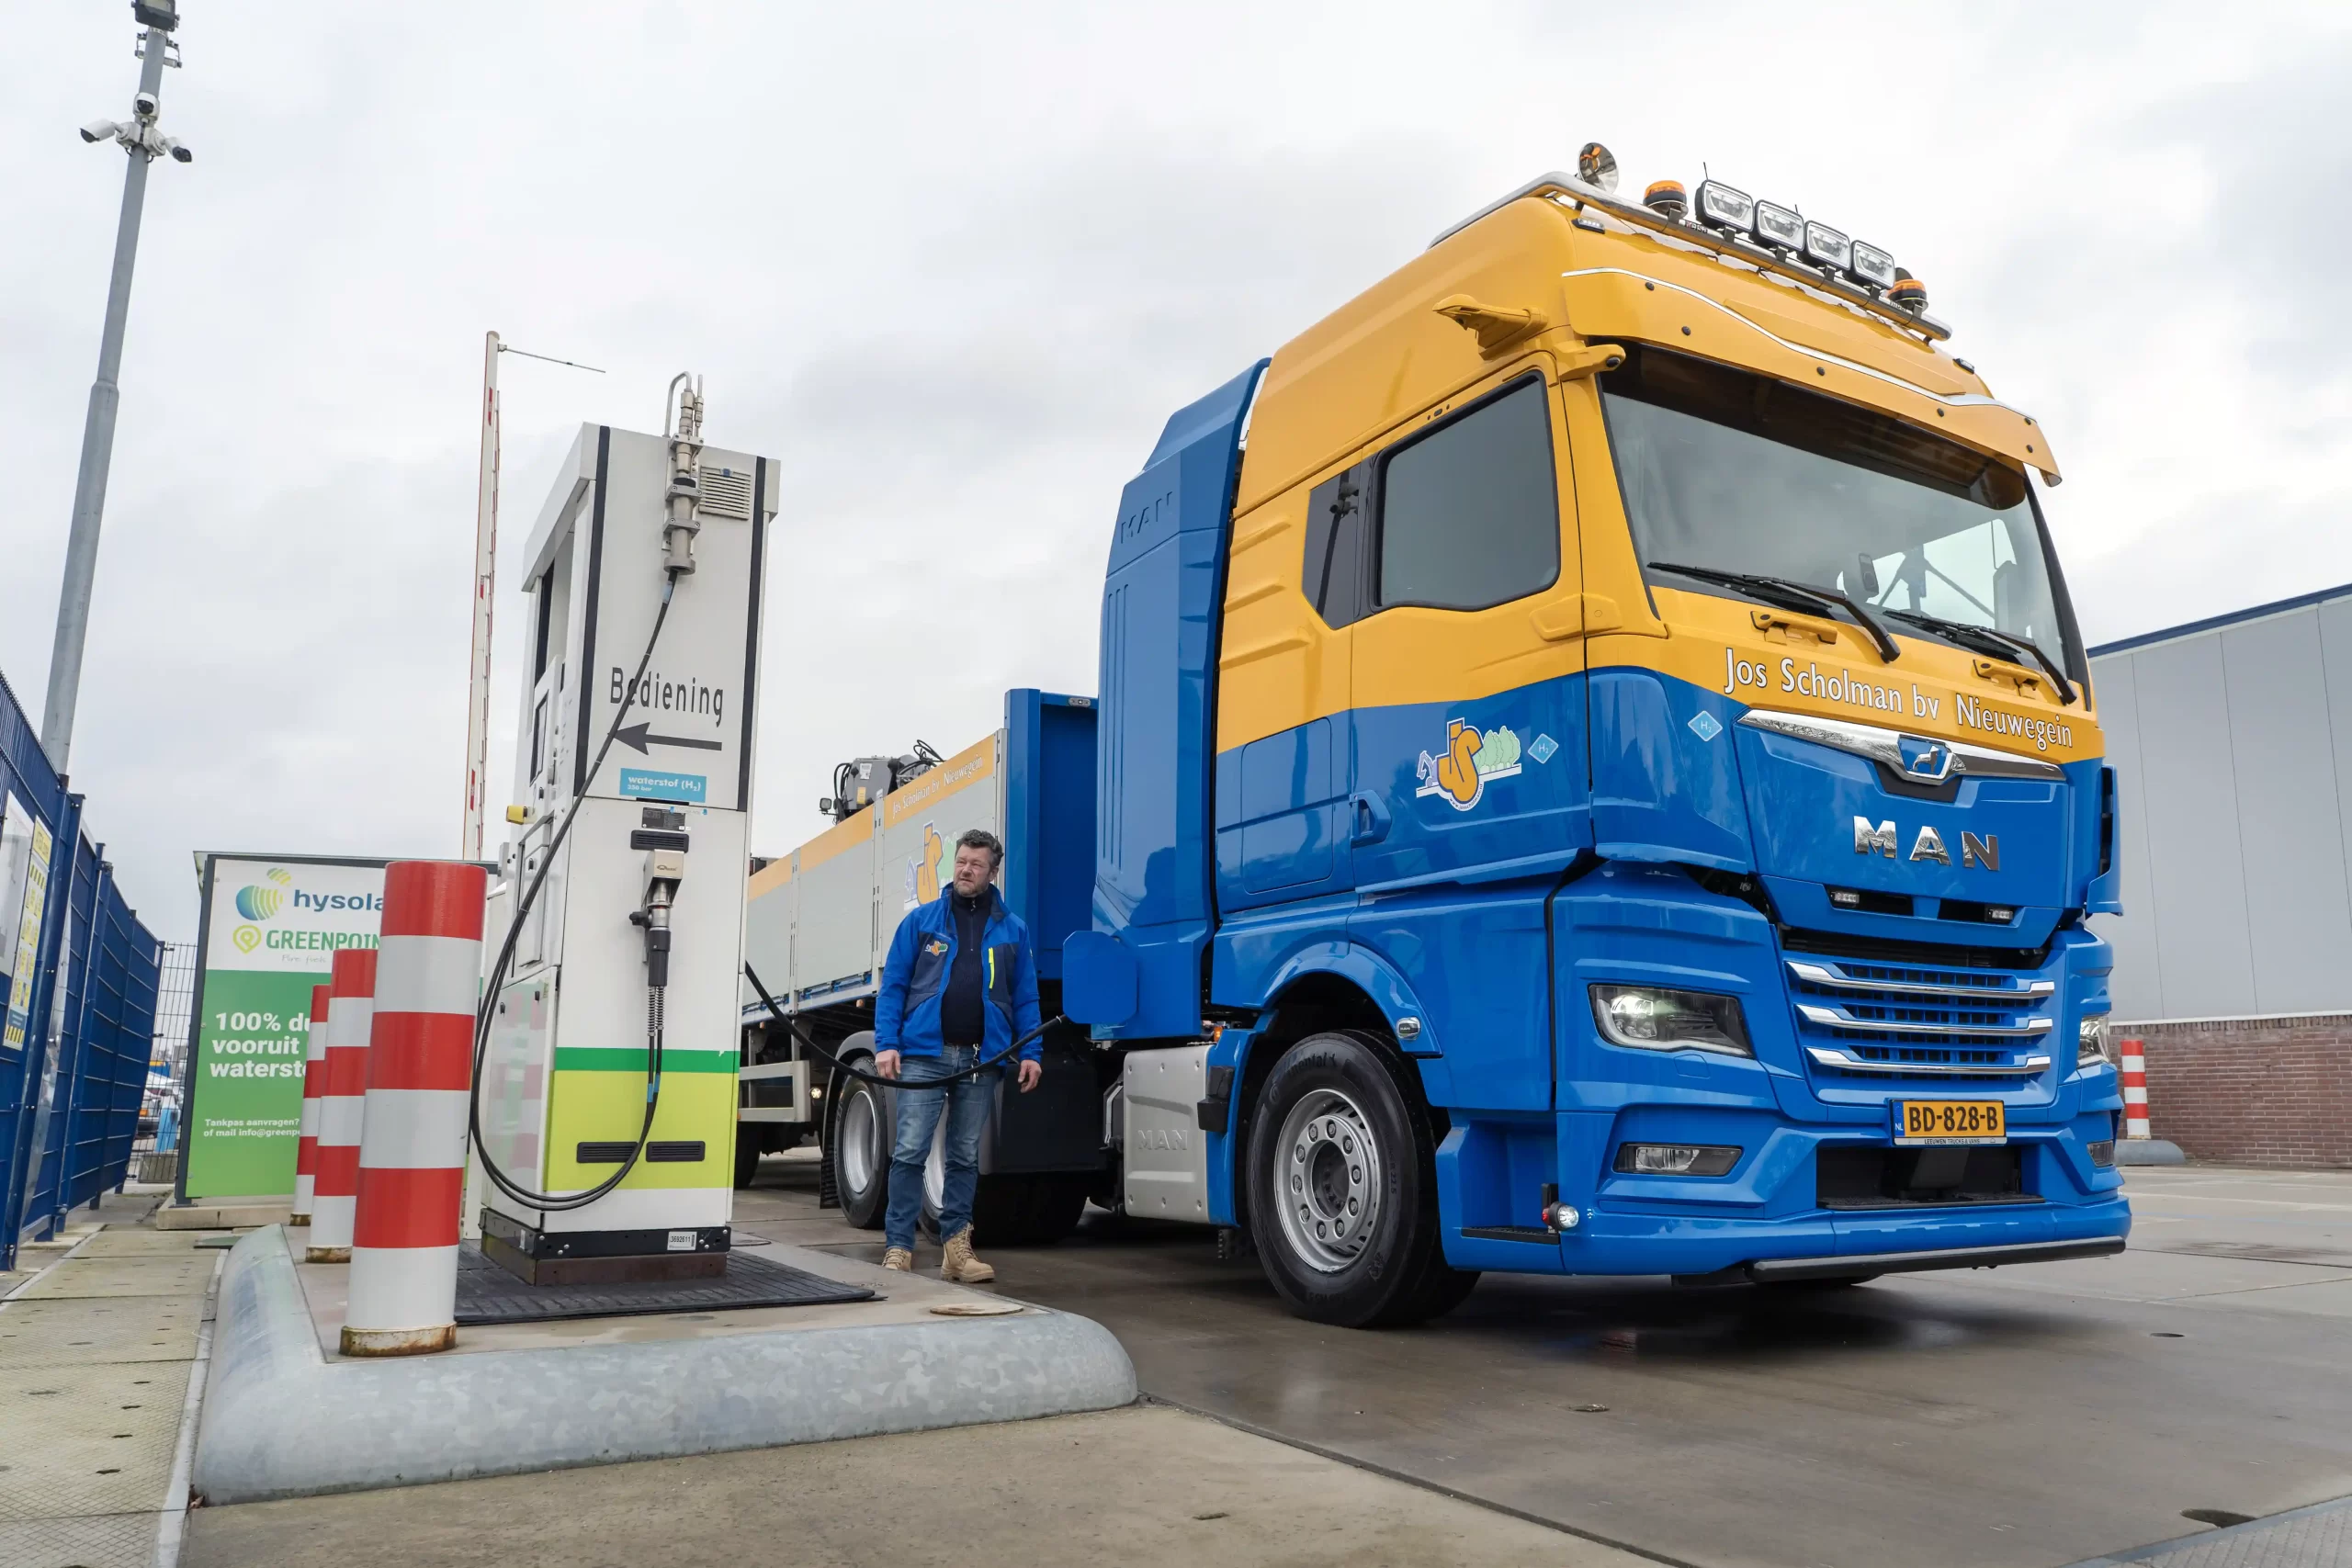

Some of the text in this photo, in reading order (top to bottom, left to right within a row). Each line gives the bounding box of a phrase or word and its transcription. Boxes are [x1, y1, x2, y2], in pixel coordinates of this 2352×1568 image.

[1724, 647, 2073, 751] Jos Scholman bv Nieuwegein
[628, 776, 679, 787] waterstof
[892, 753, 983, 819] Jos Scholman bv Nieuwegein
[1853, 816, 2000, 871] MAN
[293, 889, 384, 912] hysola
[266, 930, 380, 952] GREENPOIN
[216, 1012, 281, 1032] 100%
[211, 1035, 300, 1055] vooruit
[205, 1118, 300, 1128] Tankpas aanvragen?
[1894, 1122, 1904, 1131] NL
[1908, 1106, 1998, 1132] BD-828-B
[203, 1129, 214, 1137] of
[215, 1129, 236, 1137] mail
[1137, 1129, 1188, 1150] MAN
